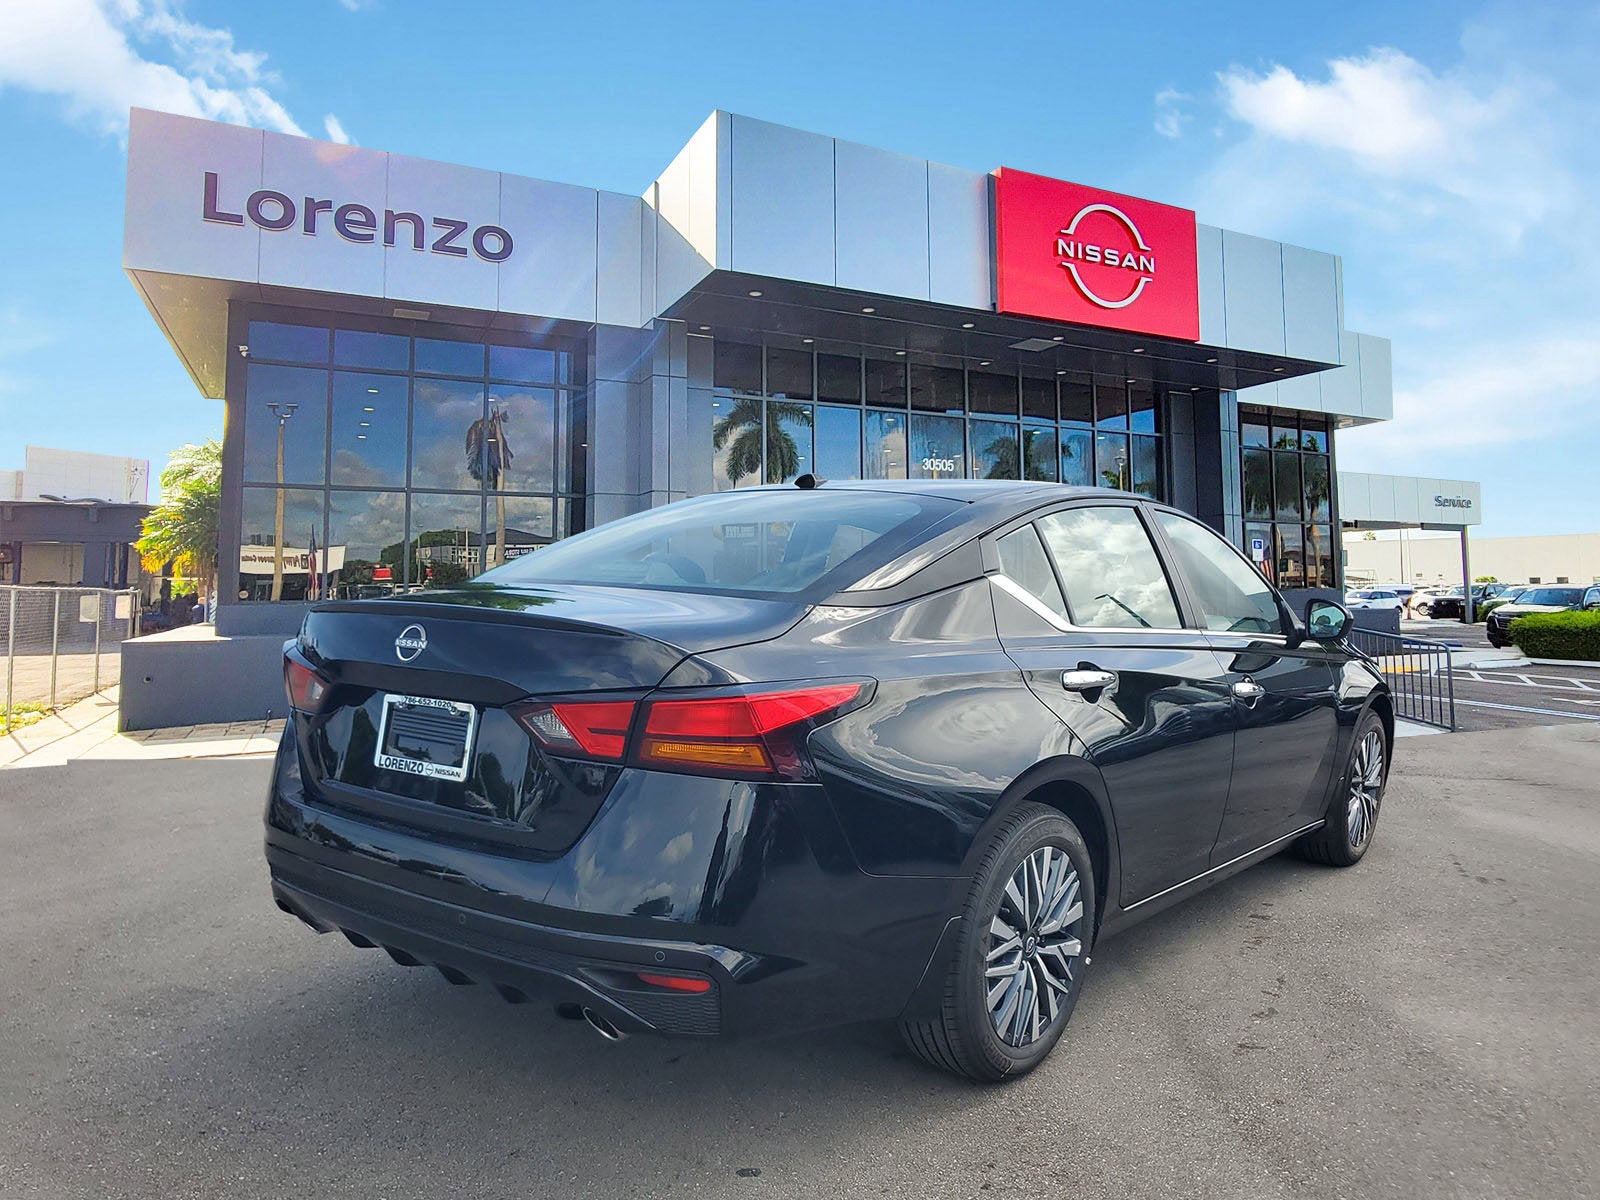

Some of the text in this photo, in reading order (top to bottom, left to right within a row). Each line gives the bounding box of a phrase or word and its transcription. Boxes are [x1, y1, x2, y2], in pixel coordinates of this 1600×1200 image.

[203, 171, 514, 262] Lorenzo
[1057, 238, 1155, 273] NISSAN
[922, 458, 954, 471] 30505
[1434, 495, 1472, 508] Service
[395, 638, 428, 650] NISSAN
[403, 696, 452, 708] 786-652-1020
[378, 756, 461, 778] LORENZO NISSAN
